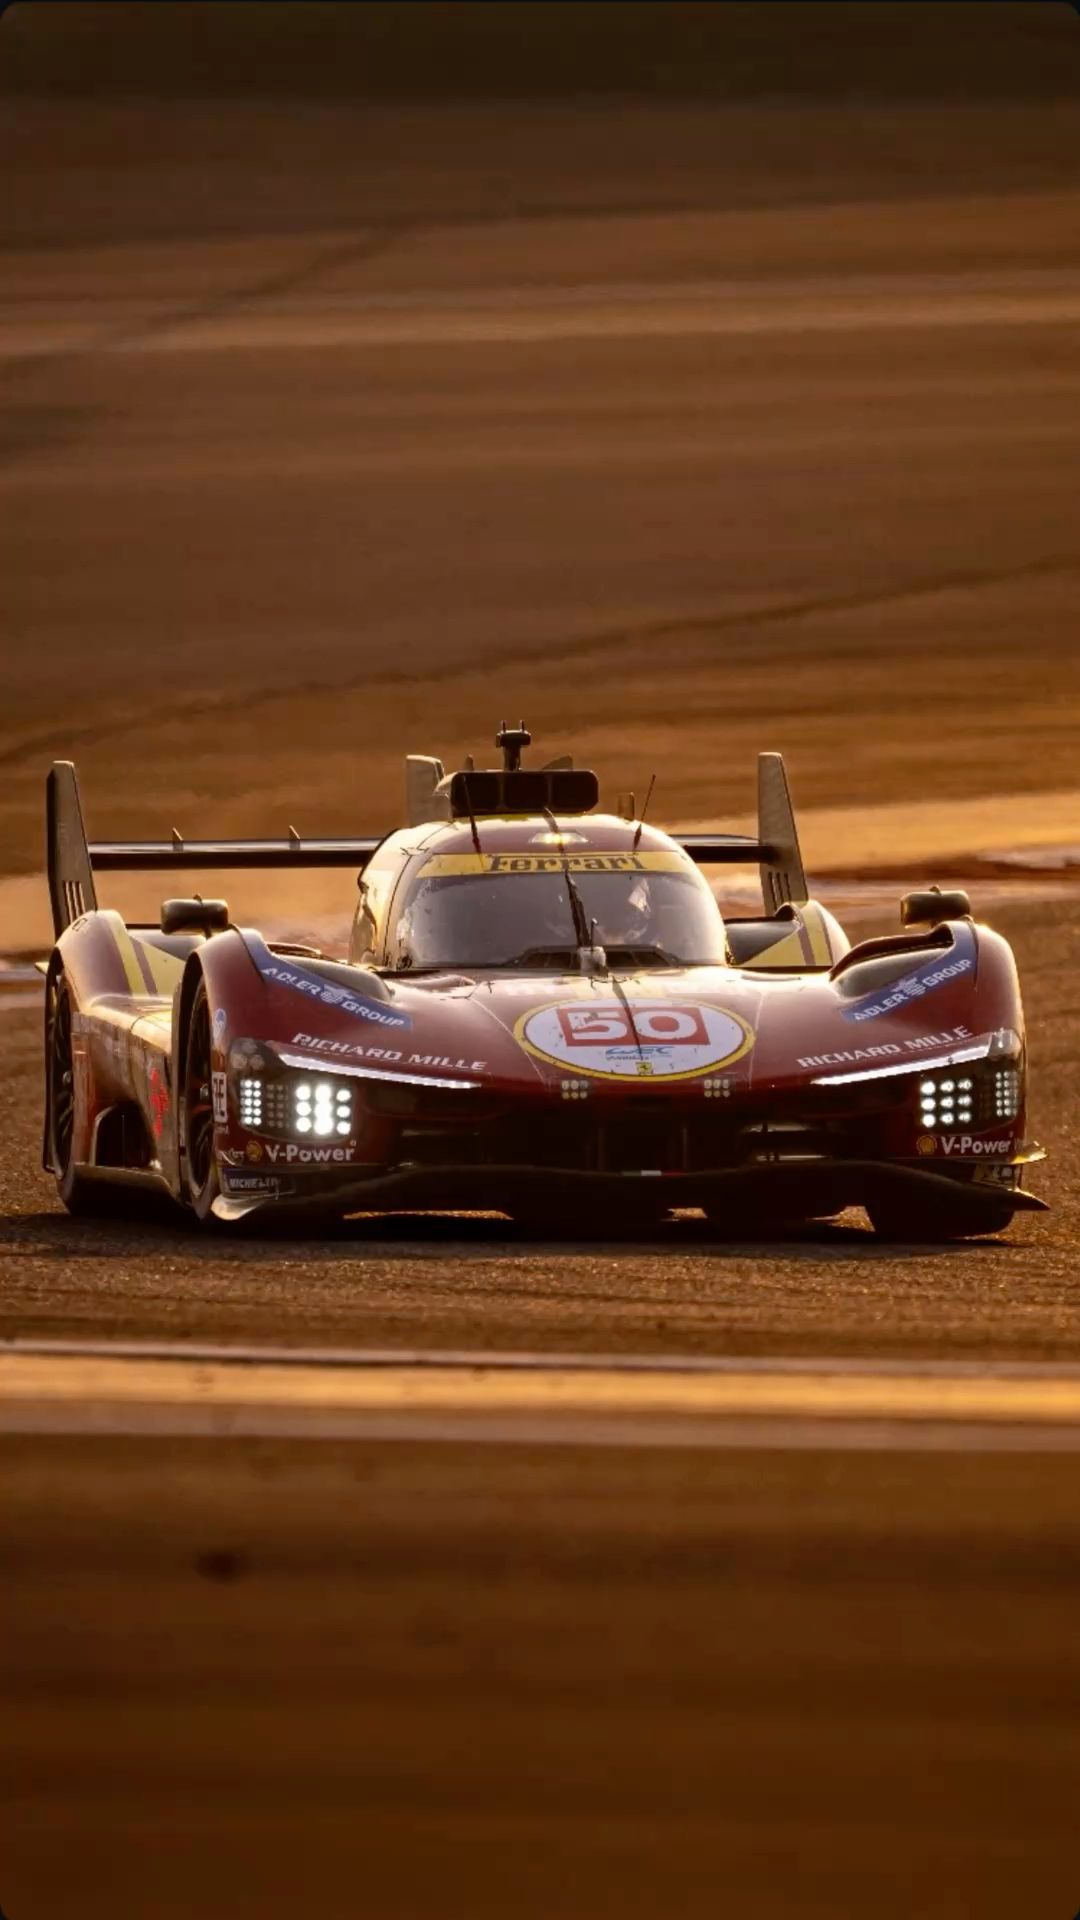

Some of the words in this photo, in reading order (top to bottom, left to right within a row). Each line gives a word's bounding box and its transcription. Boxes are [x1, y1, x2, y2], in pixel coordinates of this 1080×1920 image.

[486, 853, 648, 872] Ferrari
[261, 967, 318, 996] ADLER
[342, 1001, 405, 1027] GROUP
[853, 992, 909, 1021] ADLER
[922, 959, 973, 987] GROUP
[567, 1010, 698, 1040] 50
[291, 1033, 402, 1061] RICHARD
[408, 1053, 488, 1071] MILLE
[797, 1043, 902, 1068] RICHARD
[904, 1025, 973, 1050] MILLE
[265, 1144, 355, 1162] V-Power
[941, 1136, 1011, 1154] V-Power
